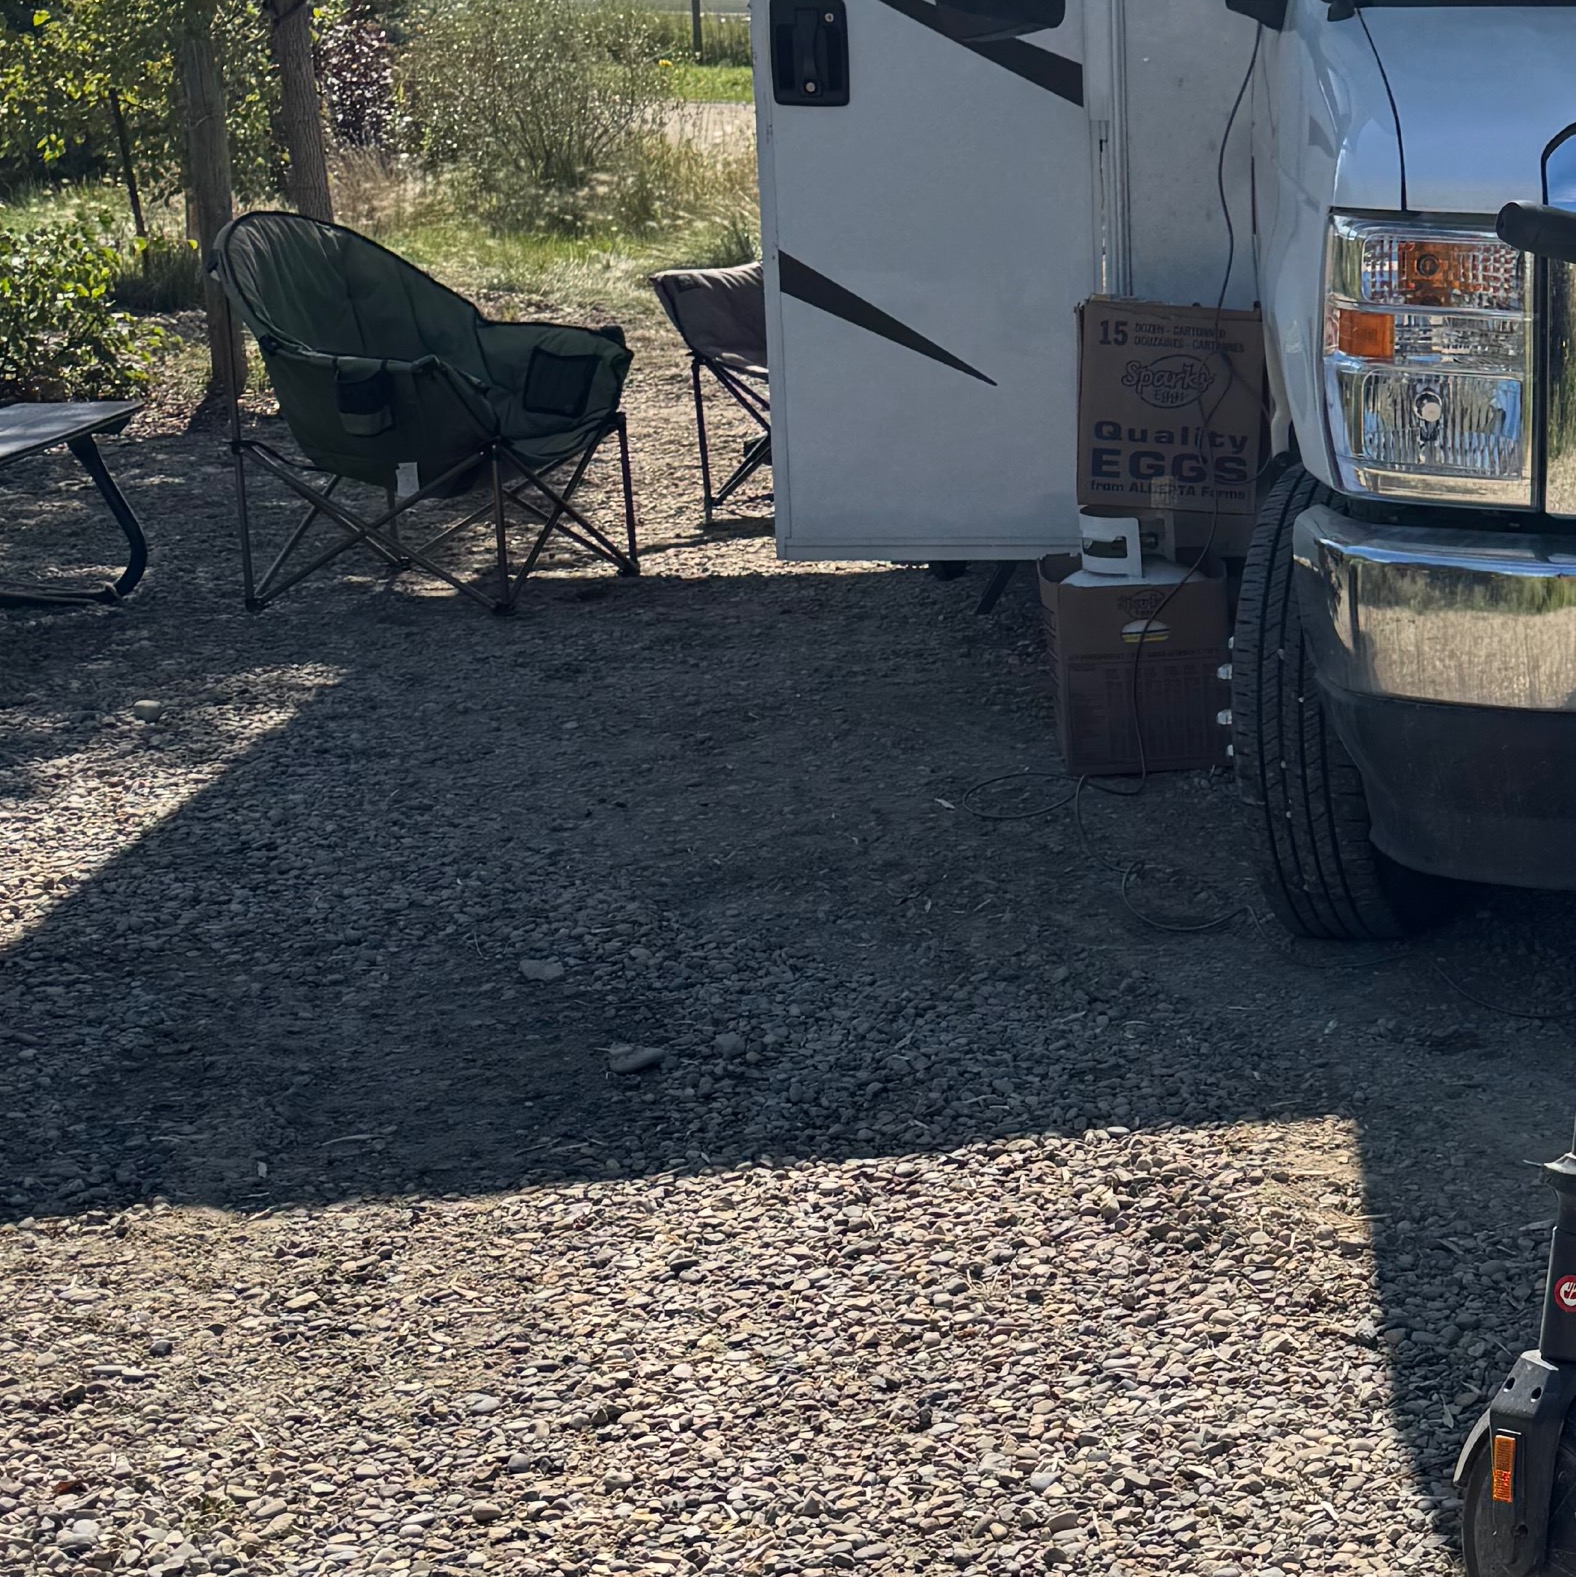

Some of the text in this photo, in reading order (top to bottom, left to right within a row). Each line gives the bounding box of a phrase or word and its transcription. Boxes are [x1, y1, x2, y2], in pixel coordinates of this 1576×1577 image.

[1098, 319, 1129, 346] 15
[1134, 322, 1165, 335] DOZEN
[1121, 360, 1216, 395] Sparky
[1154, 390, 1186, 405] Eggs
[1094, 420, 1249, 454] Quality
[1091, 447, 1248, 484] EGGS
[1090, 480, 1124, 493] from
